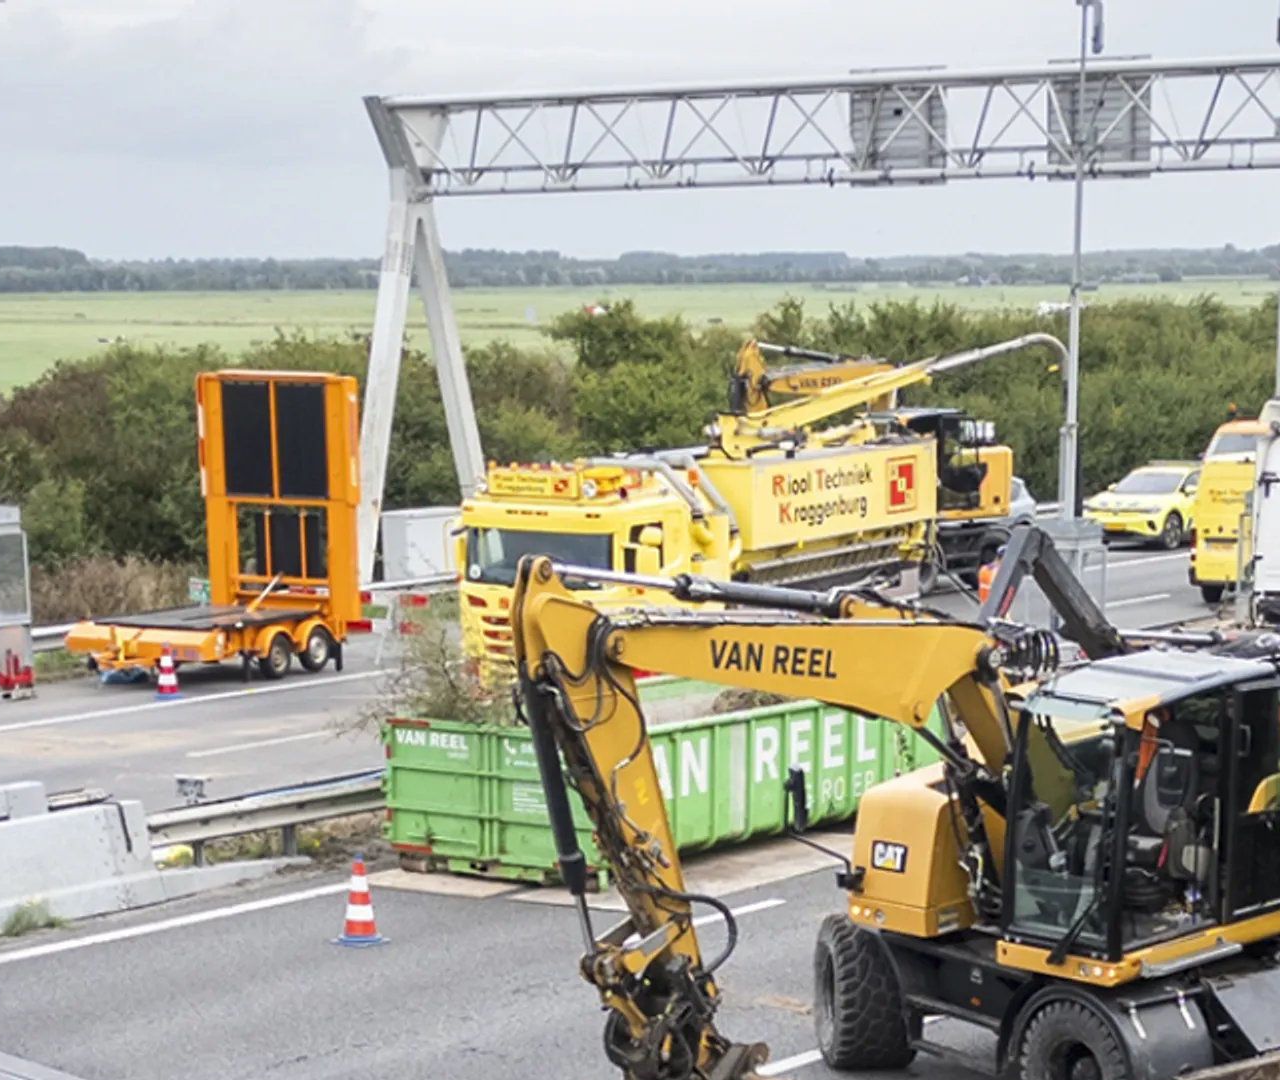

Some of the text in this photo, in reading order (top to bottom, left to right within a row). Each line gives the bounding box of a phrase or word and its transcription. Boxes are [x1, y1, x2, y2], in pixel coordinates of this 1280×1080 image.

[772, 472, 812, 497] Riool
[816, 463, 873, 490] Techniek
[779, 496, 868, 526] Kraggenburg
[710, 639, 837, 679] VAN REEL
[395, 729, 468, 750] VAN REEL
[652, 713, 876, 800] AN REEL
[874, 842, 906, 870] CAT
